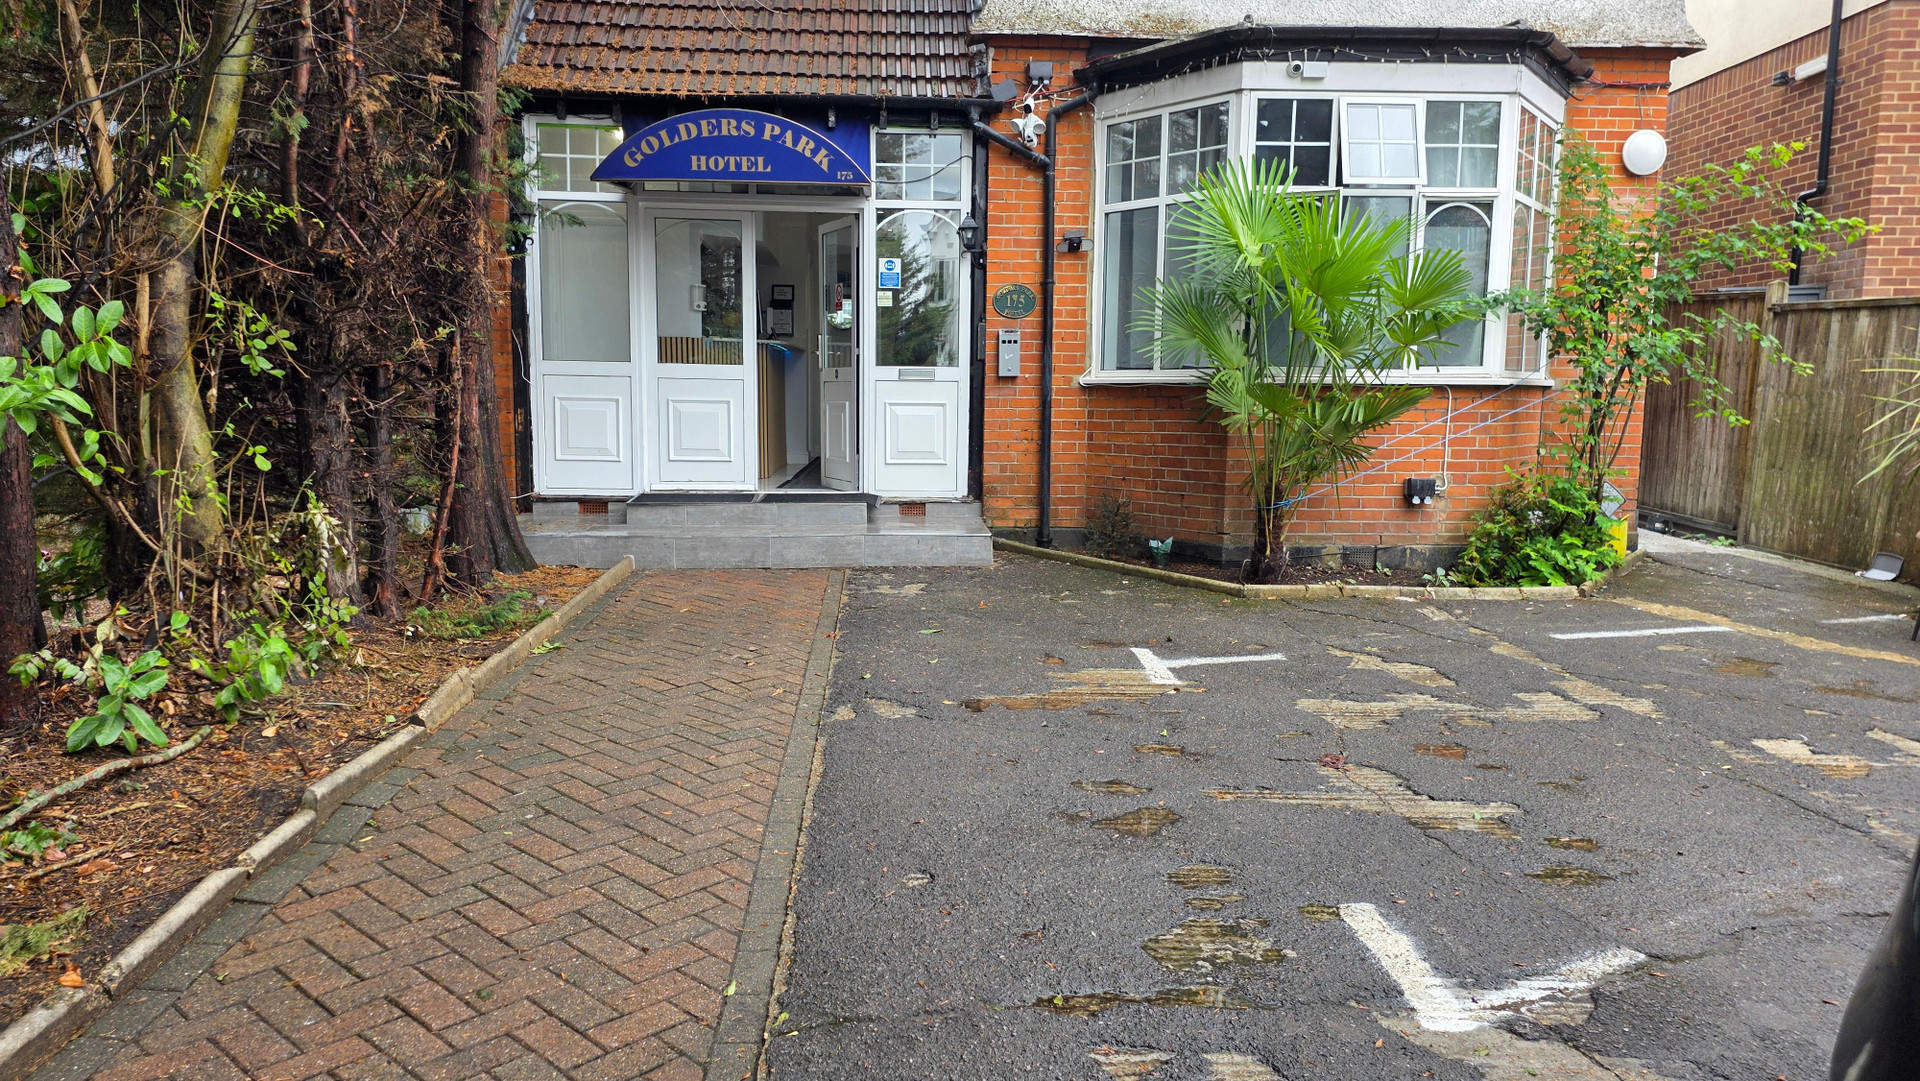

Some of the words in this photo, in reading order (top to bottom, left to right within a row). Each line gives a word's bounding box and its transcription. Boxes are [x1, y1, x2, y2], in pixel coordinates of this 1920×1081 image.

[623, 118, 755, 168] GOLDERS
[761, 122, 836, 173] PARK
[690, 155, 771, 172] HOTEL
[836, 171, 854, 180] 175
[1006, 294, 1025, 307] 175
